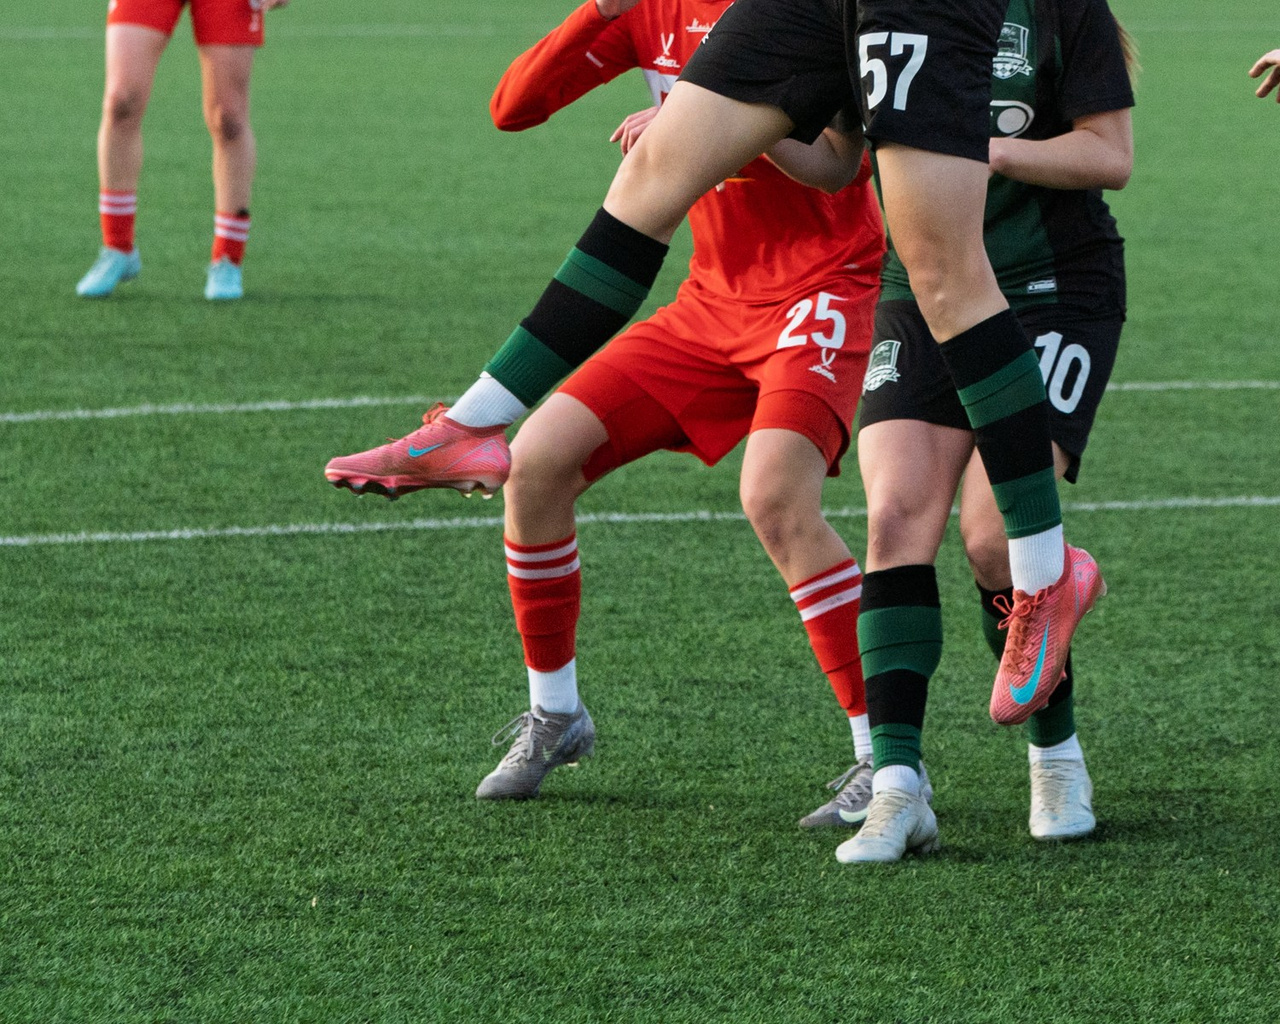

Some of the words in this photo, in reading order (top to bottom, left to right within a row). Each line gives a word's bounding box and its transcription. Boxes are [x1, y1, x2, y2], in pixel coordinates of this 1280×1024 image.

[858, 31, 928, 112] 57
[776, 291, 849, 350] 25
[1033, 330, 1091, 414] 10
